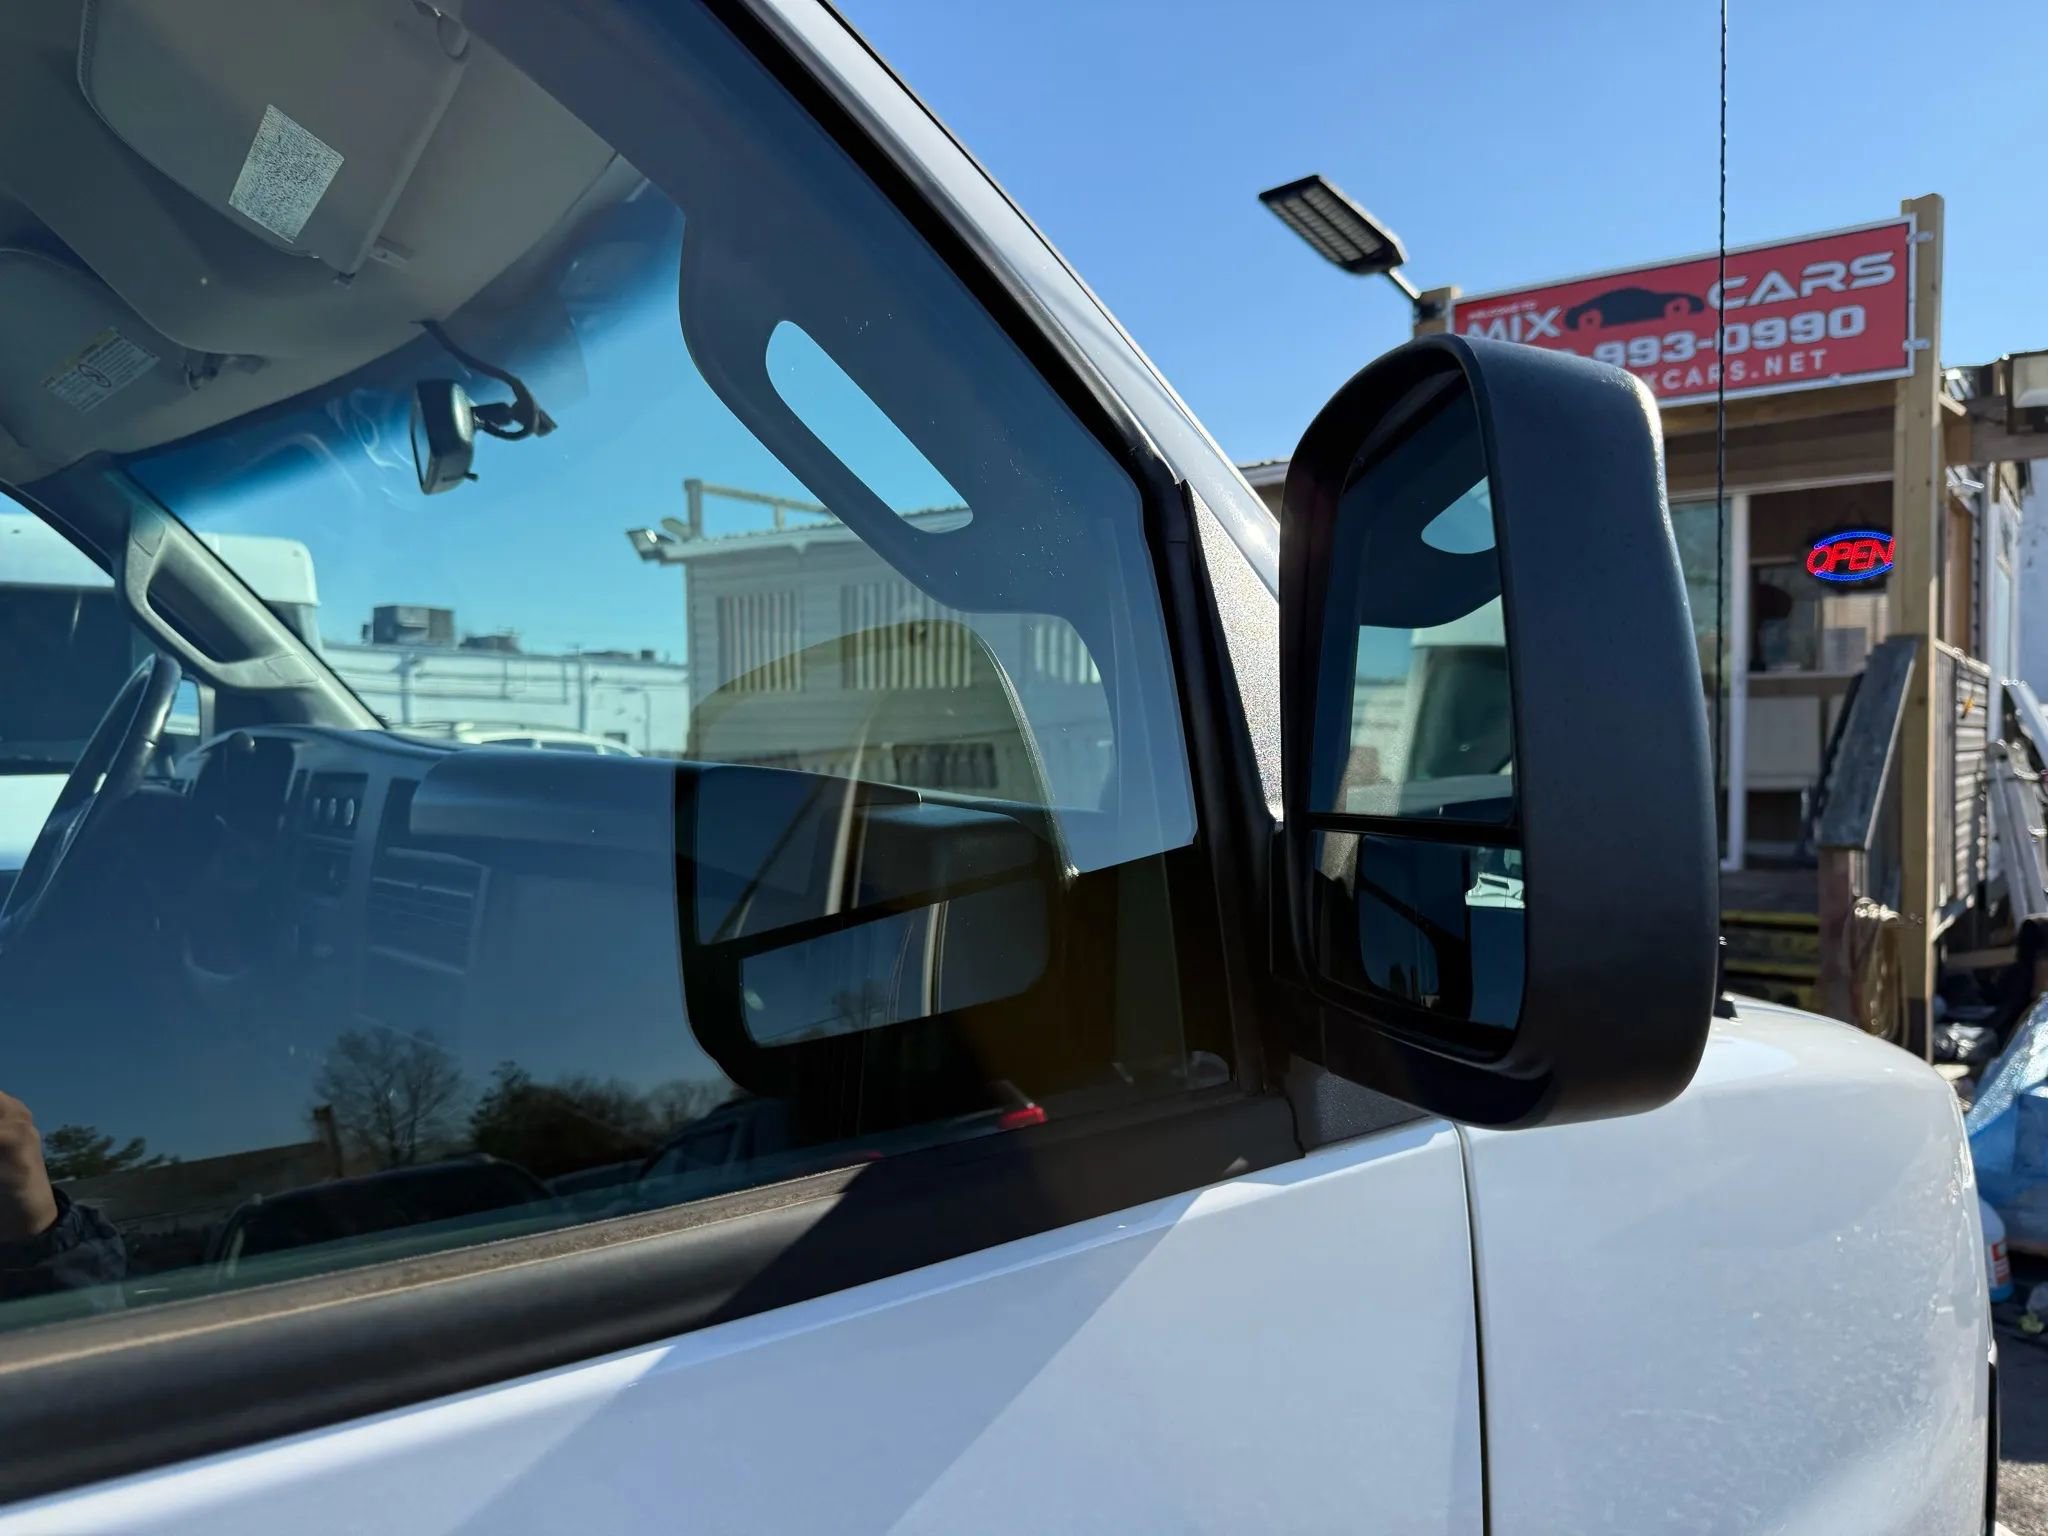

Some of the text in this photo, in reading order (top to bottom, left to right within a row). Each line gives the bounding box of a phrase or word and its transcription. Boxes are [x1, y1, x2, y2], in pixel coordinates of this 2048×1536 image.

[1467, 250, 1896, 341] MIX CARS
[1562, 304, 1866, 368] 993-0990
[1807, 537, 1896, 574] OPEN
